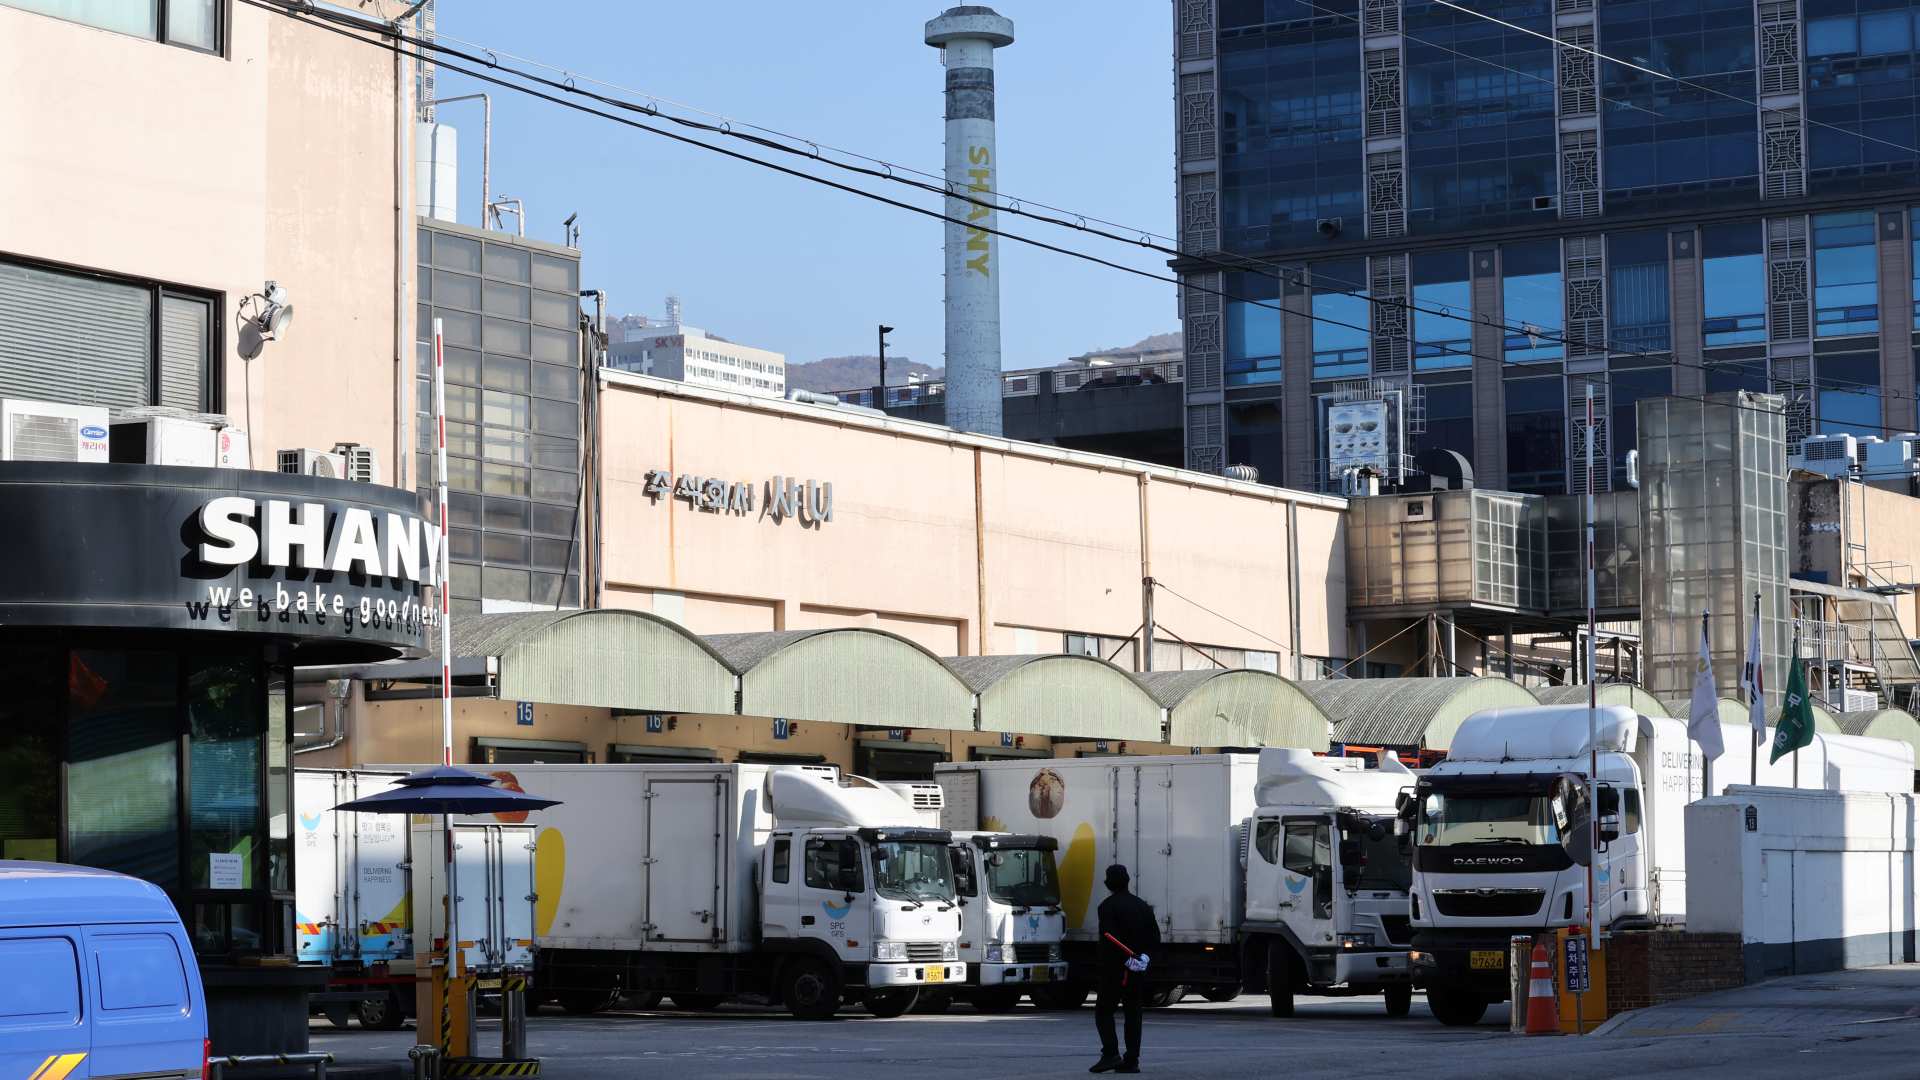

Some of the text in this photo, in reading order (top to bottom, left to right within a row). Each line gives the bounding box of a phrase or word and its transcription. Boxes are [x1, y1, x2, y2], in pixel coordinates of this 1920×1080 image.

[967, 145, 989, 278] SHANY
[646, 470, 832, 523] 주식회사 샤니
[199, 496, 441, 587] SHANY
[208, 585, 253, 608] we
[276, 581, 344, 614] bake
[518, 703, 532, 721] 15
[648, 715, 660, 729] 16
[774, 718, 787, 736] 17
[1003, 732, 1012, 743] 19
[1453, 857, 1524, 865] DAEWOO
[830, 921, 845, 930] SPC
[1567, 940, 1579, 989] 출차주의
